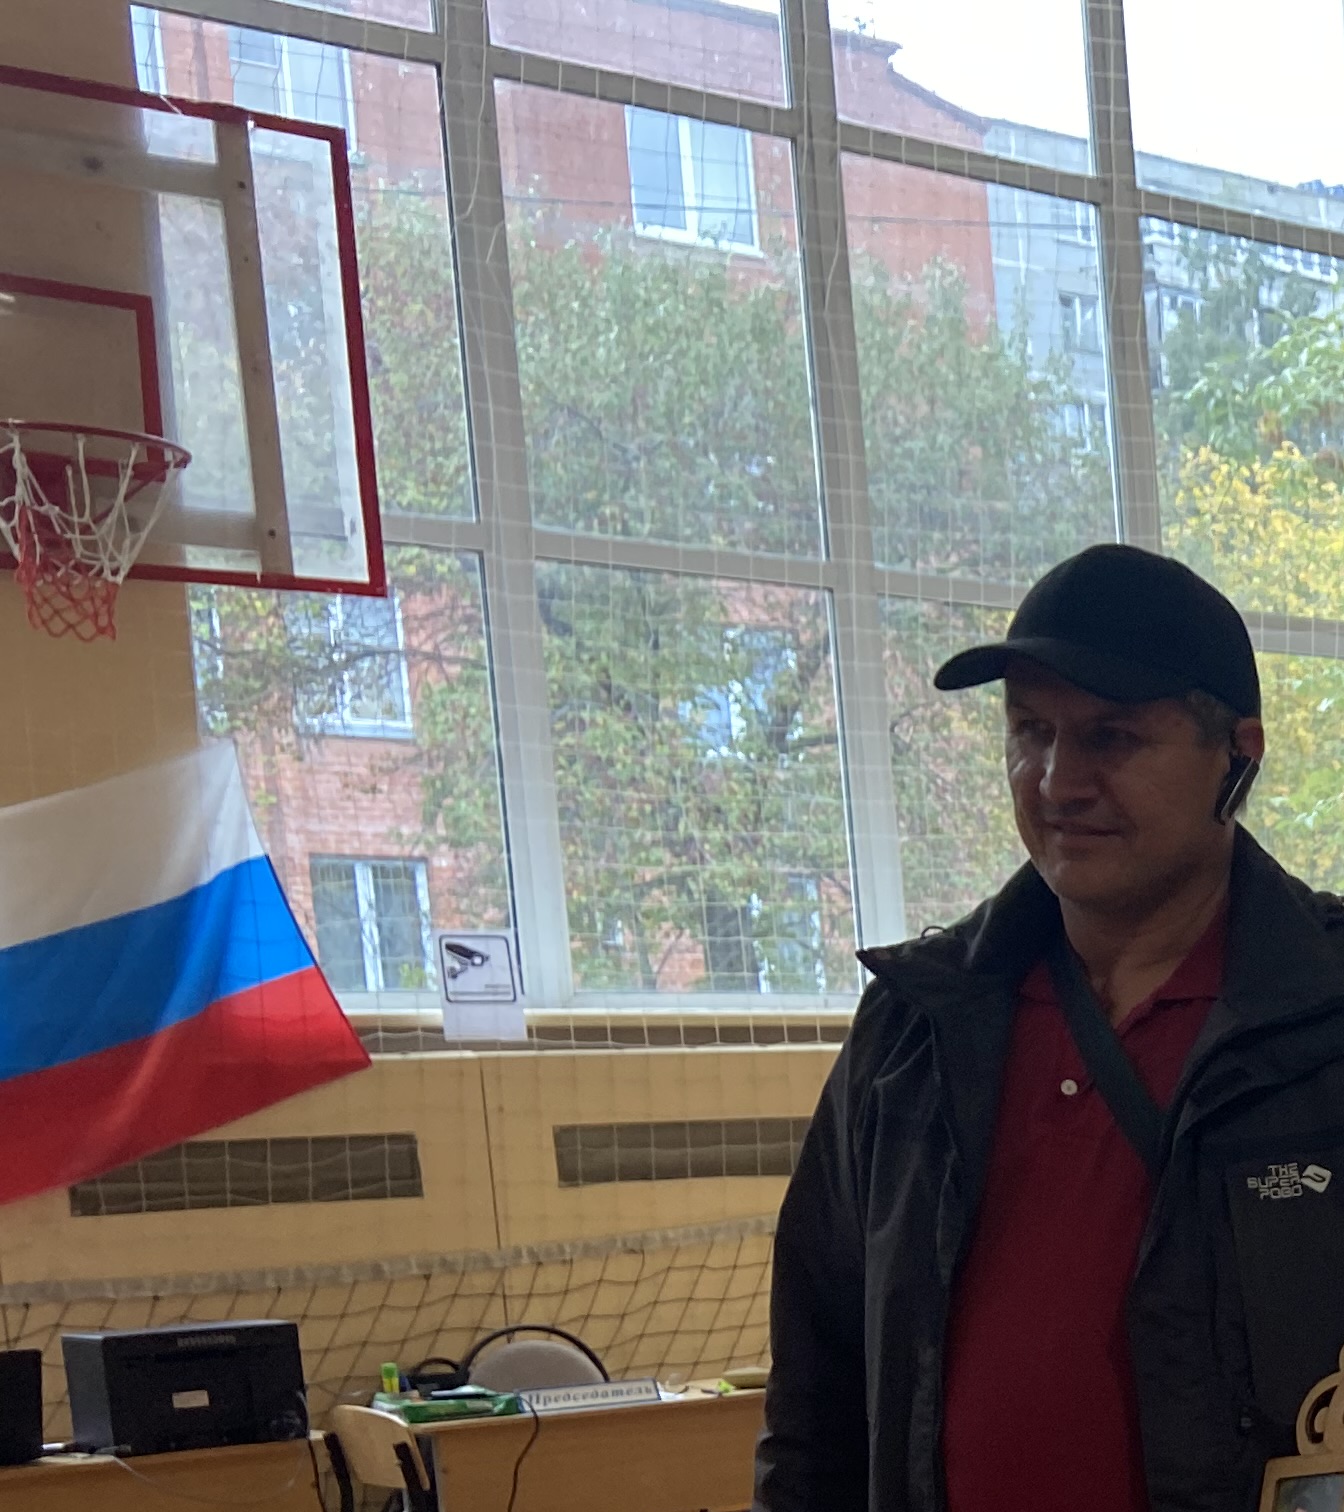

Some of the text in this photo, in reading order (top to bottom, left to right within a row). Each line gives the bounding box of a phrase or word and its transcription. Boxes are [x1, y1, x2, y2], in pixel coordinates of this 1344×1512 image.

[1267, 1162, 1299, 1178] THE
[1247, 1174, 1302, 1189] SUPER
[528, 1385, 653, 1407] Председатель
